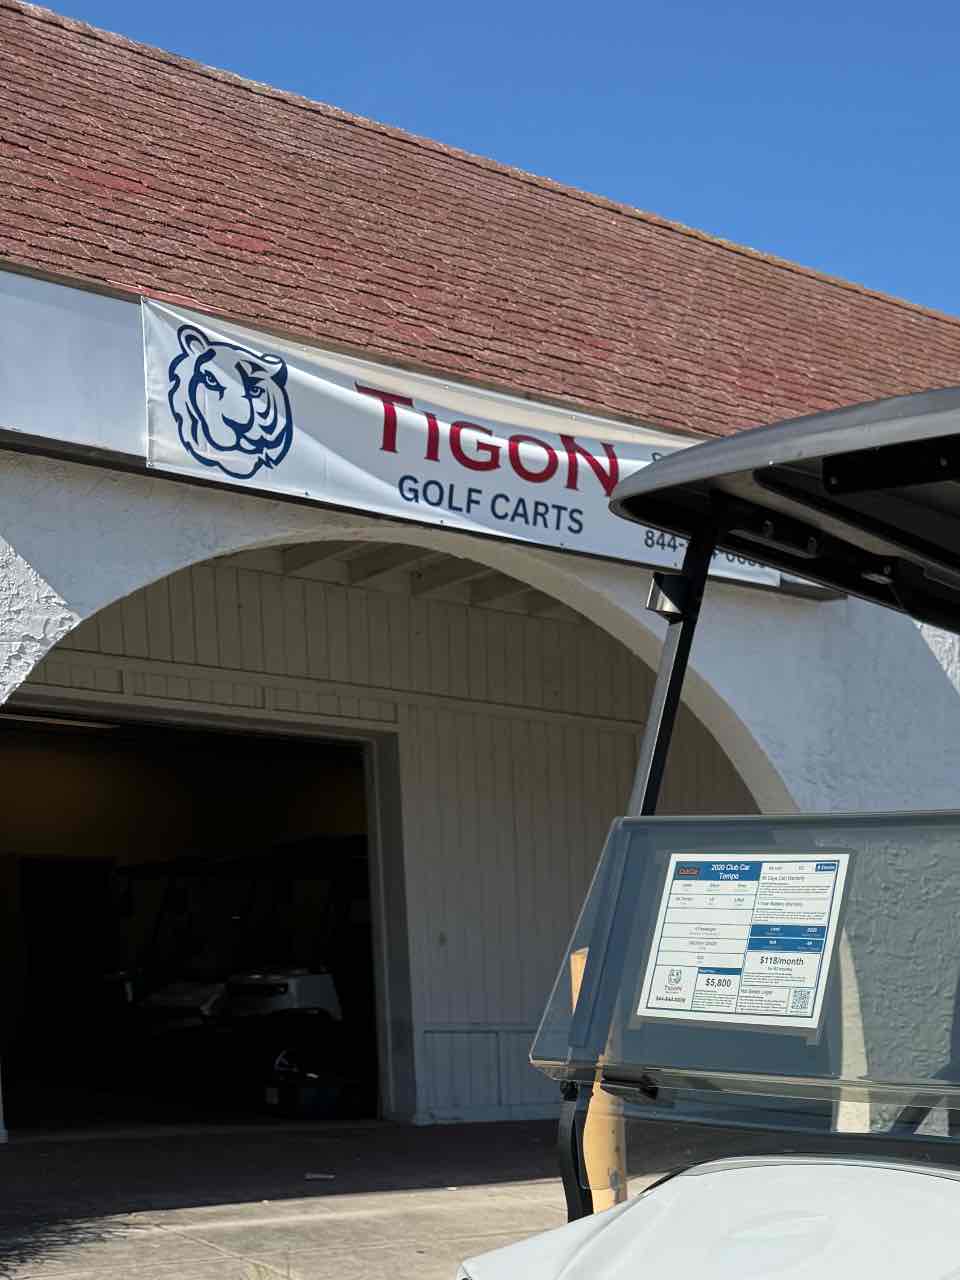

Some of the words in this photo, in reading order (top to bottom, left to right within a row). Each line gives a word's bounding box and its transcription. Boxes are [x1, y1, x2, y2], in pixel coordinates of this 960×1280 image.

[354, 381, 621, 498] TIGON
[397, 475, 481, 514] GOLF
[490, 493, 585, 535] CARTS
[760, 956, 804, 966] $118/month
[705, 978, 732, 988] $5,800
